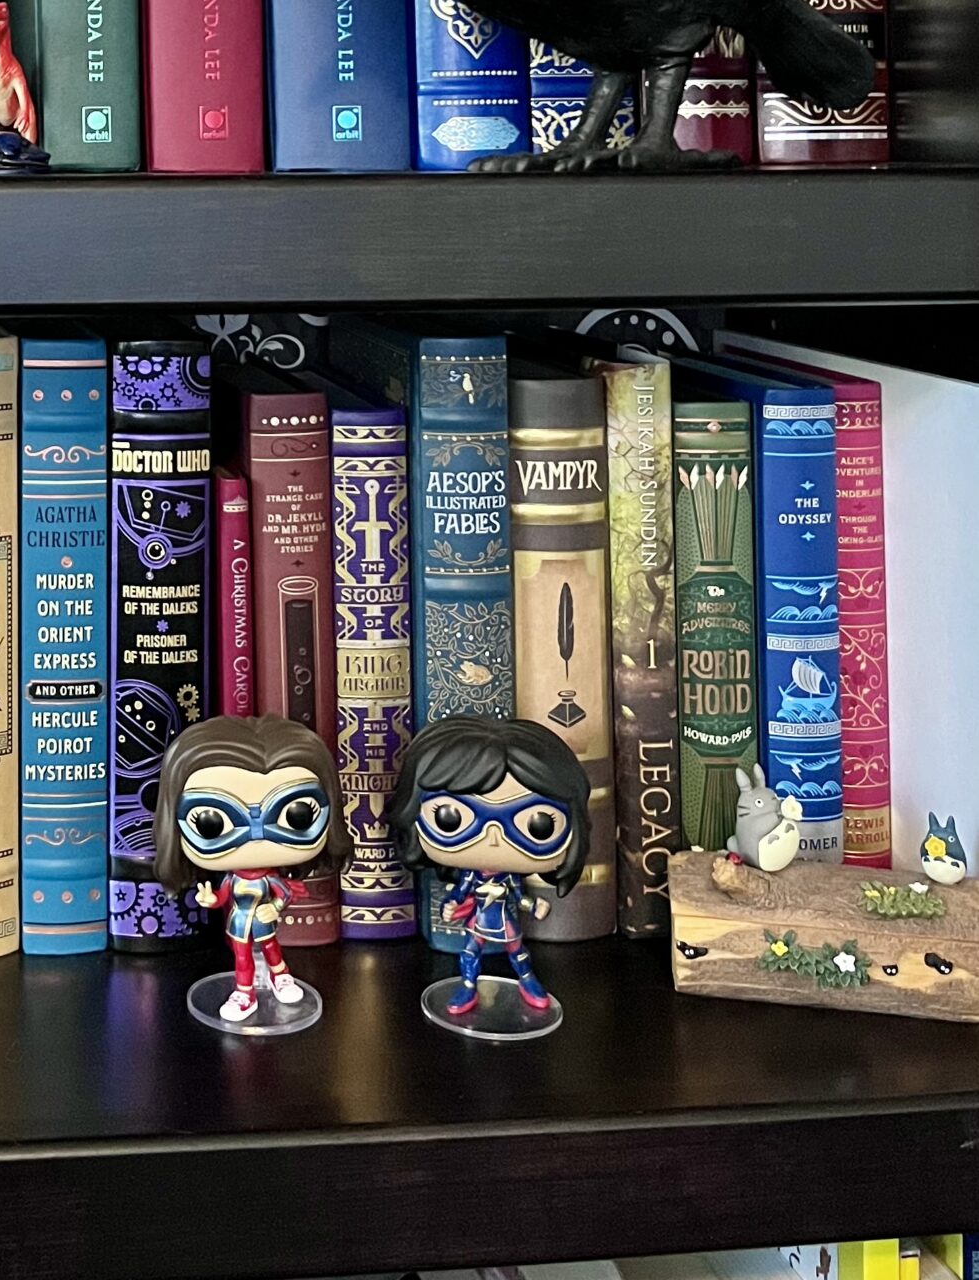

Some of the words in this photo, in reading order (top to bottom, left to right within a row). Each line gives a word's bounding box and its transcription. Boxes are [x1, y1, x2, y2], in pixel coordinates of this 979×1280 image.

[88, 50, 104, 82] LEE
[204, 49, 220, 81] LEE
[337, 49, 354, 82] LEE
[85, 131, 109, 141] orbit
[335, 131, 359, 140] orbit
[633, 384, 656, 475] JESIKAH
[112, 447, 173, 473] DOCTOR
[177, 449, 211, 473] WHO
[426, 470, 506, 494] AESOP'S
[515, 458, 602, 497] VAMPYR
[265, 493, 303, 502] STRANGE
[425, 495, 506, 510] ILLUSTRATED
[795, 497, 819, 508] THE
[35, 506, 97, 523] AGATHA
[287, 512, 324, 523] JEKYLL
[778, 513, 832, 525] ODYSSEY
[433, 512, 501, 535] FABLES
[639, 480, 658, 568] SUNDIN
[27, 530, 105, 548] CHRISTIE
[293, 535, 319, 544] OTHER
[280, 545, 314, 554] STORIES
[360, 562, 386, 573] THE
[36, 573, 94, 590] MURDER
[122, 584, 200, 599] REMEMBRANCE
[341, 586, 405, 604] STORY
[37, 600, 59, 617] ON
[65, 600, 93, 616] THE
[162, 601, 198, 615] DALEKS
[231, 557, 249, 648] CHRISTMAS
[364, 618, 383, 628] OF
[38, 626, 93, 643] ORIENT
[136, 634, 187, 649] PRISONER
[34, 652, 96, 670] EXPRESS
[162, 649, 198, 664] DALEKS
[345, 653, 403, 675] KING
[35, 686, 56, 696] AND
[60, 685, 96, 695] OTHER
[233, 656, 251, 713] CAROL
[343, 676, 405, 691] ARTHUR
[683, 683, 752, 715] HOOD
[32, 711, 98, 729] HERCULE
[363, 722, 388, 731] AND
[37, 738, 92, 754] POIROT
[25, 762, 105, 781] MYSTERIES
[638, 739, 674, 899] LEGACY
